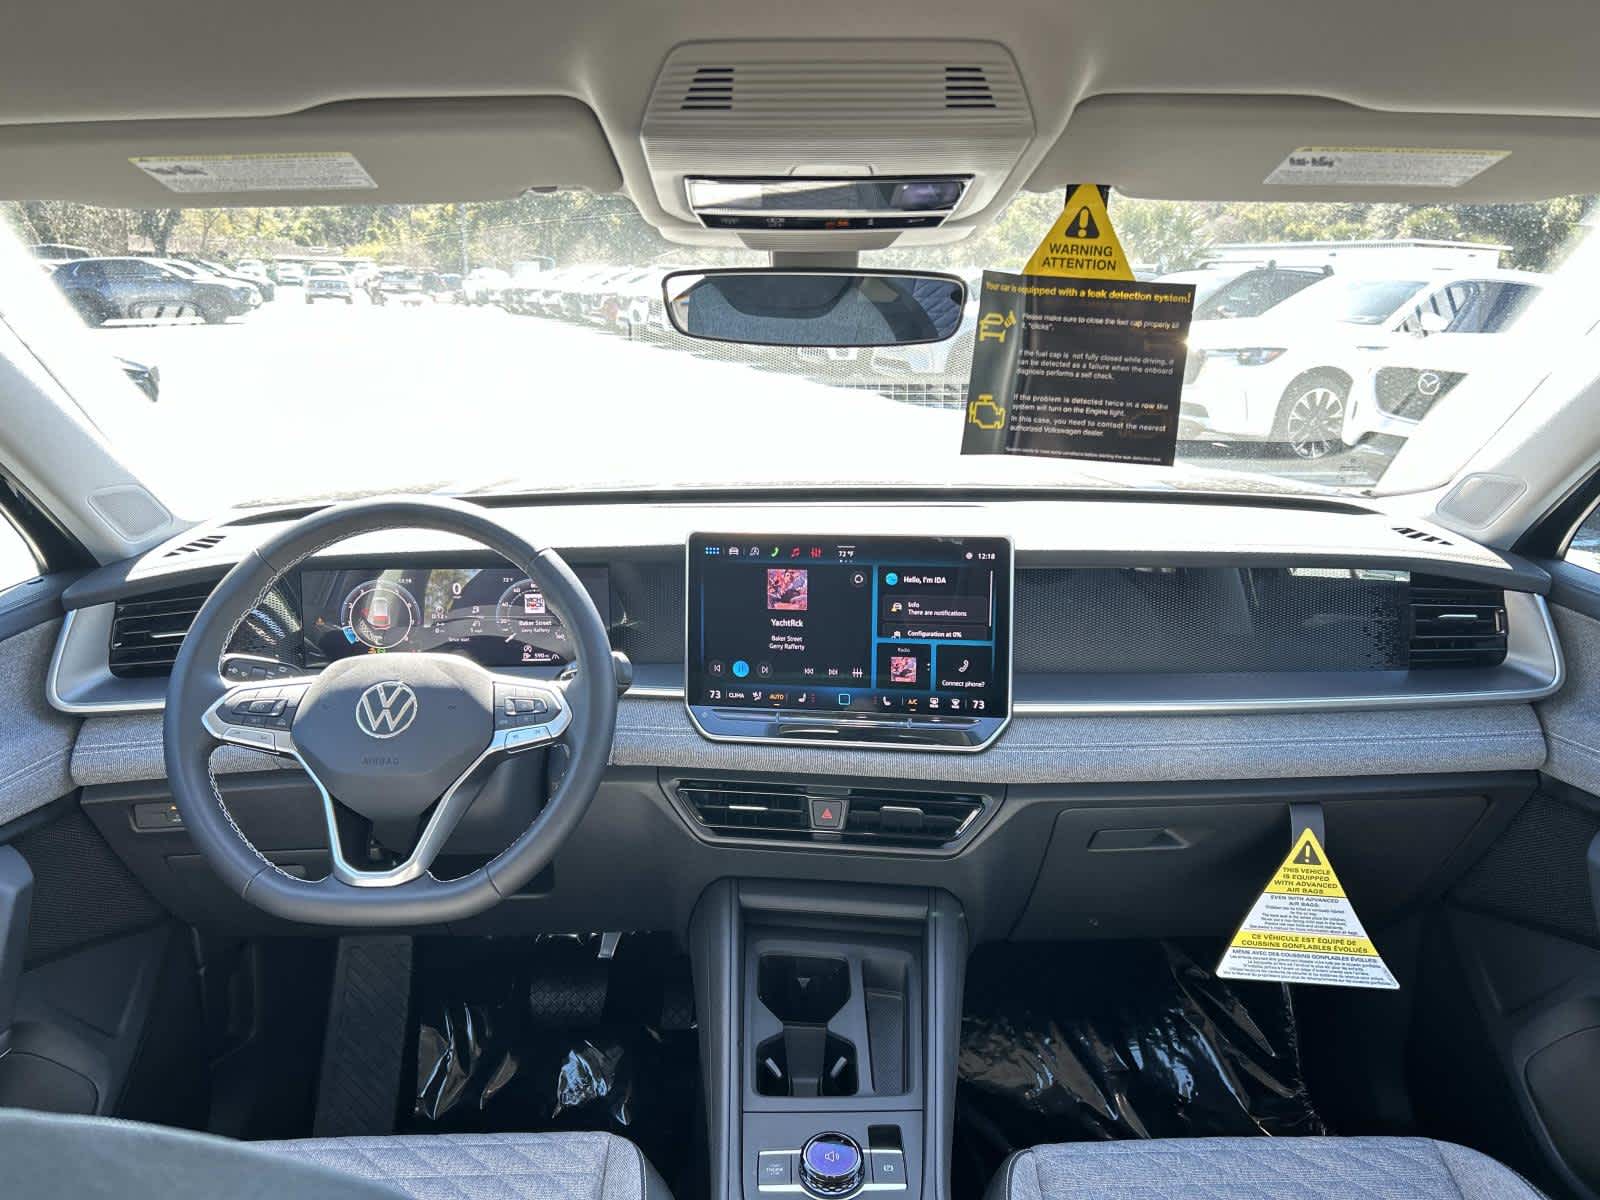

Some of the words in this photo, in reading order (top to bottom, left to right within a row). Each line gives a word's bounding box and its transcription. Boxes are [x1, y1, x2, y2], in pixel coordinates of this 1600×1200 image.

[1049, 243, 1113, 257] WARNING
[1041, 256, 1117, 272] ATTENTION
[1017, 286, 1057, 297] equipped
[1058, 288, 1078, 297] with
[1079, 290, 1085, 298] a
[1087, 289, 1107, 299] leak
[1109, 290, 1152, 301] detection
[1154, 292, 1191, 303] system!
[1105, 317, 1115, 325] the
[1072, 352, 1083, 360] not
[1085, 352, 1098, 362] fully
[1100, 355, 1122, 363] closed
[1041, 360, 1071, 368] detected
[1088, 362, 1110, 370] failure
[1131, 366, 1143, 374] the
[1144, 367, 1174, 375] onboard
[1046, 369, 1074, 378] performs
[1032, 395, 1061, 403] problem
[1071, 397, 1103, 406] detected
[1104, 400, 1124, 408] twice
[1012, 403, 1035, 411] system
[1048, 405, 1061, 413] turn
[1073, 406, 1084, 414] the
[1085, 407, 1109, 416] Engine
[1019, 415, 1032, 423] this
[1097, 421, 1124, 429] contact
[1125, 422, 1137, 430] the
[1138, 424, 1166, 432] nearest
[1043, 425, 1082, 436] Volkswagen
[903, 576, 922, 585] Hello,
[922, 576, 933, 584] I'm
[452, 582, 462, 595] 0
[907, 630, 945, 638] Configuration
[784, 643, 805, 651] Rafferty
[964, 680, 985, 688] phone?
[709, 690, 721, 699] 73
[358, 682, 417, 736] VW
[972, 699, 985, 709] 73
[1292, 874, 1330, 882] EQUIPPED
[1295, 881, 1338, 889] ADVANCED
[1305, 896, 1340, 904] ADVANCED
[1241, 939, 1281, 948] COUSSINS
[1282, 942, 1332, 951] GONFLABLES
[1333, 945, 1368, 954] ÉVOLUÉS
[1280, 951, 1310, 959] COUSSINS
[1311, 954, 1349, 962] GONFLABLES
